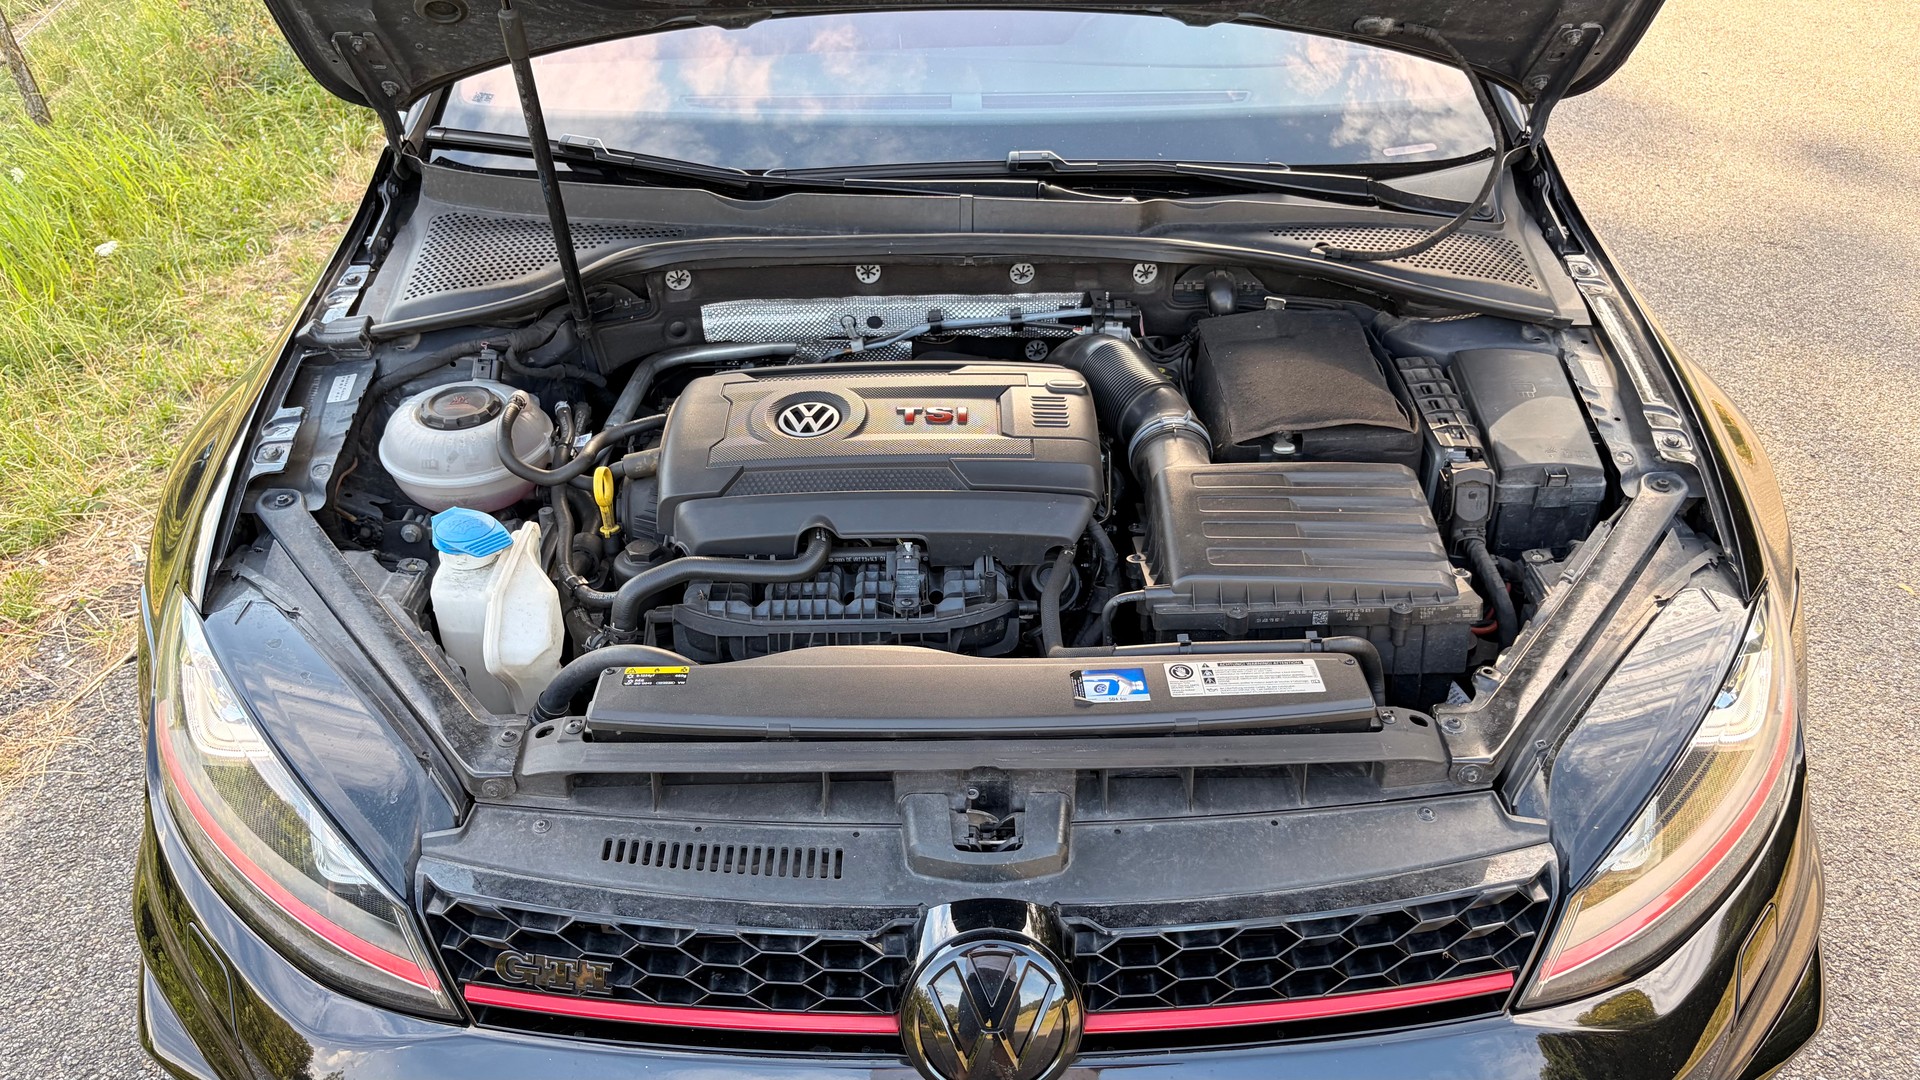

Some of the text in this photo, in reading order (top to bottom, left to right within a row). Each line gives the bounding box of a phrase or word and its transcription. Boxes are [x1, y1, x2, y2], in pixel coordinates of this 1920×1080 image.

[780, 402, 840, 436] VW
[896, 406, 969, 425] TSI
[494, 950, 614, 995] GTI
[908, 936, 1078, 1079] VW
